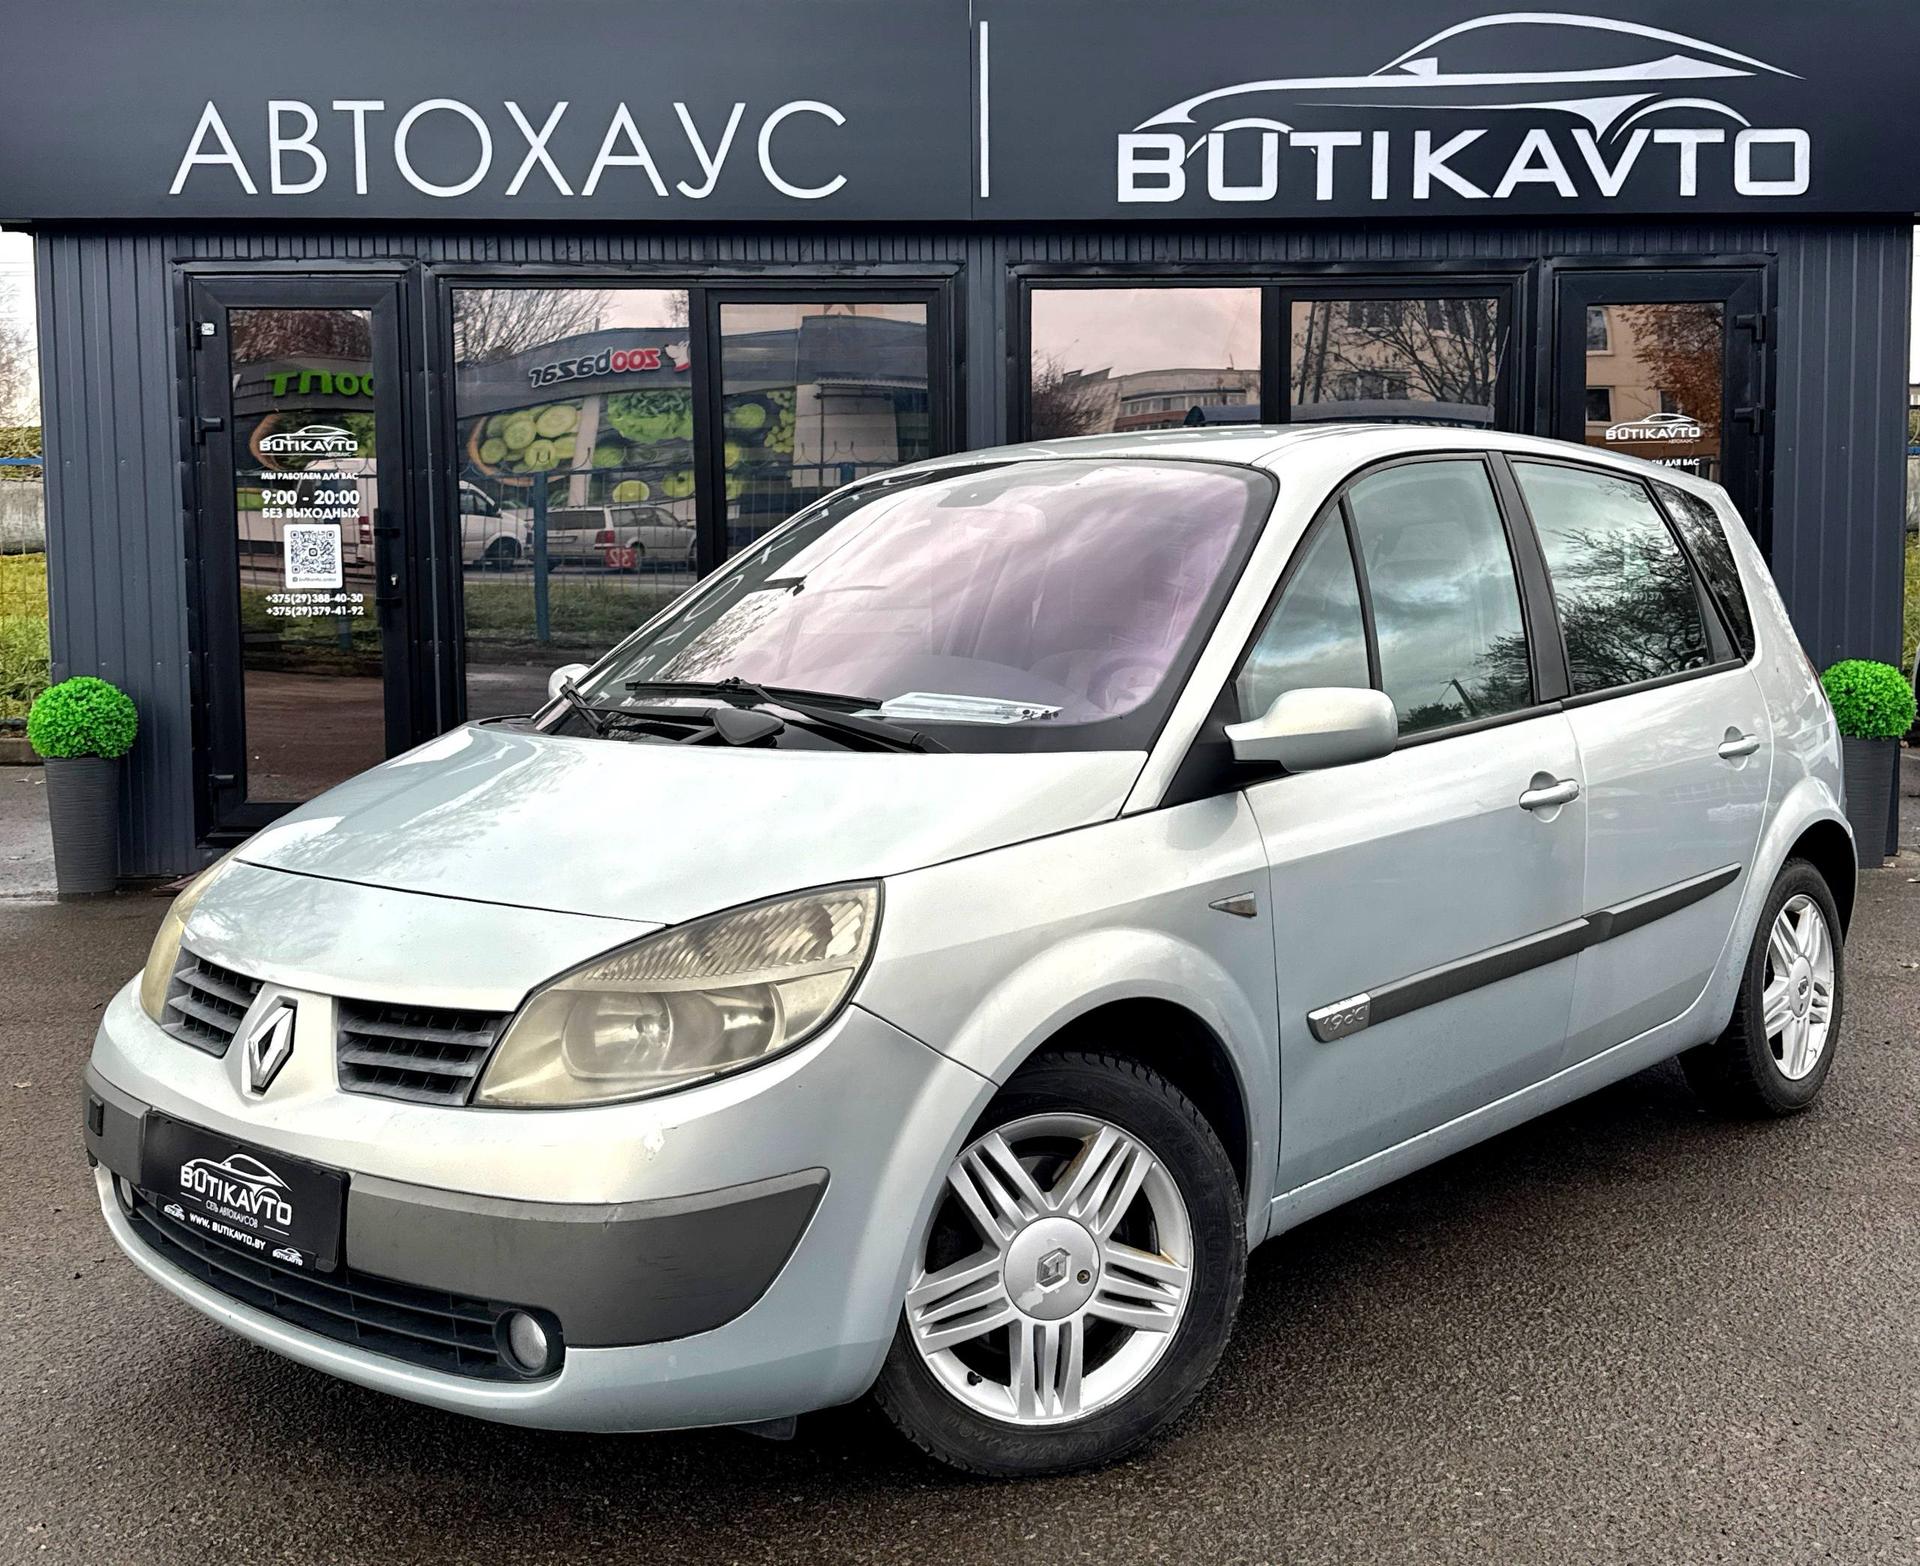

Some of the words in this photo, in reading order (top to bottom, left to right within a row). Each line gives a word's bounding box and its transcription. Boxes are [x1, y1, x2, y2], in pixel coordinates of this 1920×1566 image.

[169, 99, 848, 199] АВТОХАУС
[1117, 128, 1811, 202] BUTIKAVTO
[1605, 427, 1700, 440] BUTIKAVTO
[259, 440, 359, 452] BUTIKAVTO
[1683, 458, 1700, 466] ВАС
[322, 473, 340, 481] ДЛЯ
[261, 490, 297, 505] 9:00
[313, 490, 360, 505] 20:00
[262, 508, 282, 519] БЕЗ
[286, 508, 360, 519] ВЫХОДНЫХ
[265, 593, 364, 605] +375(29)388-40-30
[266, 606, 365, 617] +375(29)379-41-92
[180, 1165, 292, 1226] BUTIKAVTO
